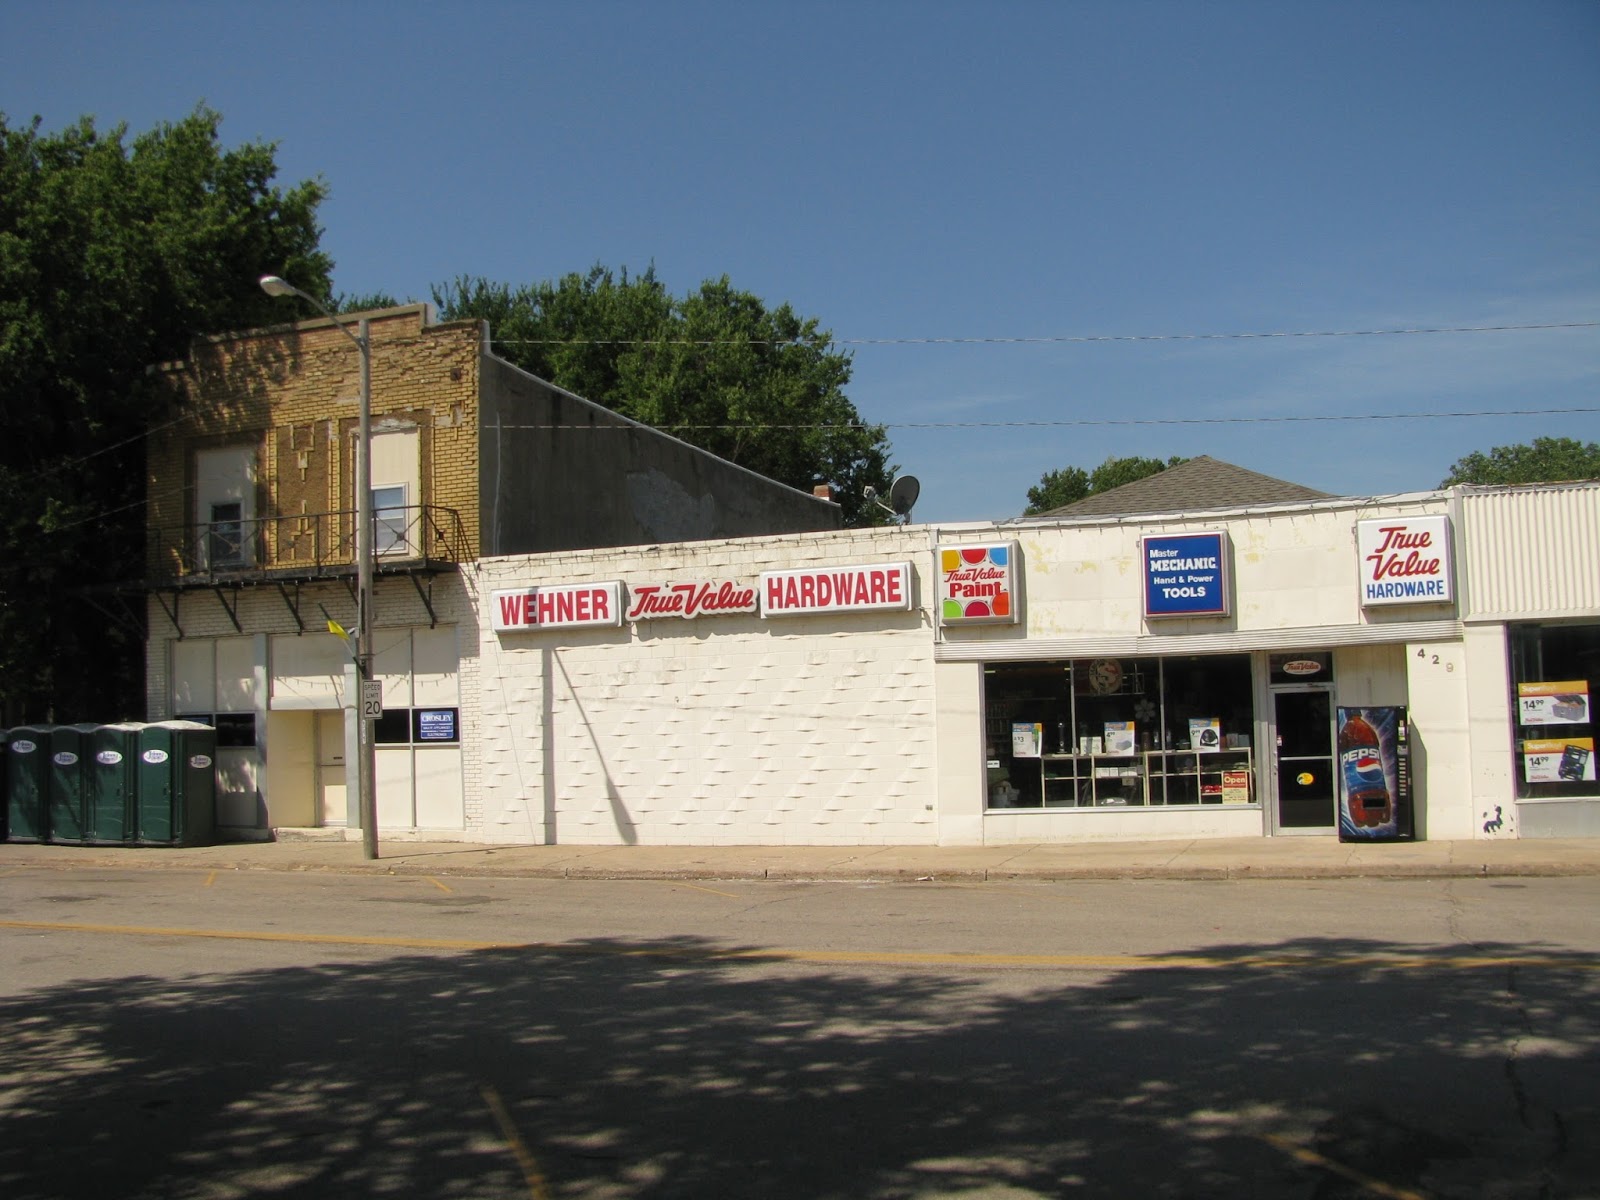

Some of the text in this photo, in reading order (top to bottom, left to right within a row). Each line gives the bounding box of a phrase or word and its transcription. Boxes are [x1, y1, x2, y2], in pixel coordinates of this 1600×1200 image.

[1374, 526, 1432, 553] True
[1149, 549, 1179, 558] Master
[1150, 557, 1216, 572] MECHANIC
[1366, 550, 1440, 581] Value
[944, 567, 1005, 583] True Value
[1153, 575, 1214, 585] Hand & Power
[949, 581, 1002, 598] Paint
[1162, 586, 1206, 599] TOOLS
[1366, 580, 1445, 599] HARDWARE
[499, 569, 902, 626] WEHNER True Value HARDWARE
[364, 683, 381, 691] SPEED
[365, 701, 381, 715] 20
[421, 714, 452, 723] CROSLEY
[1223, 775, 1246, 785] Open
